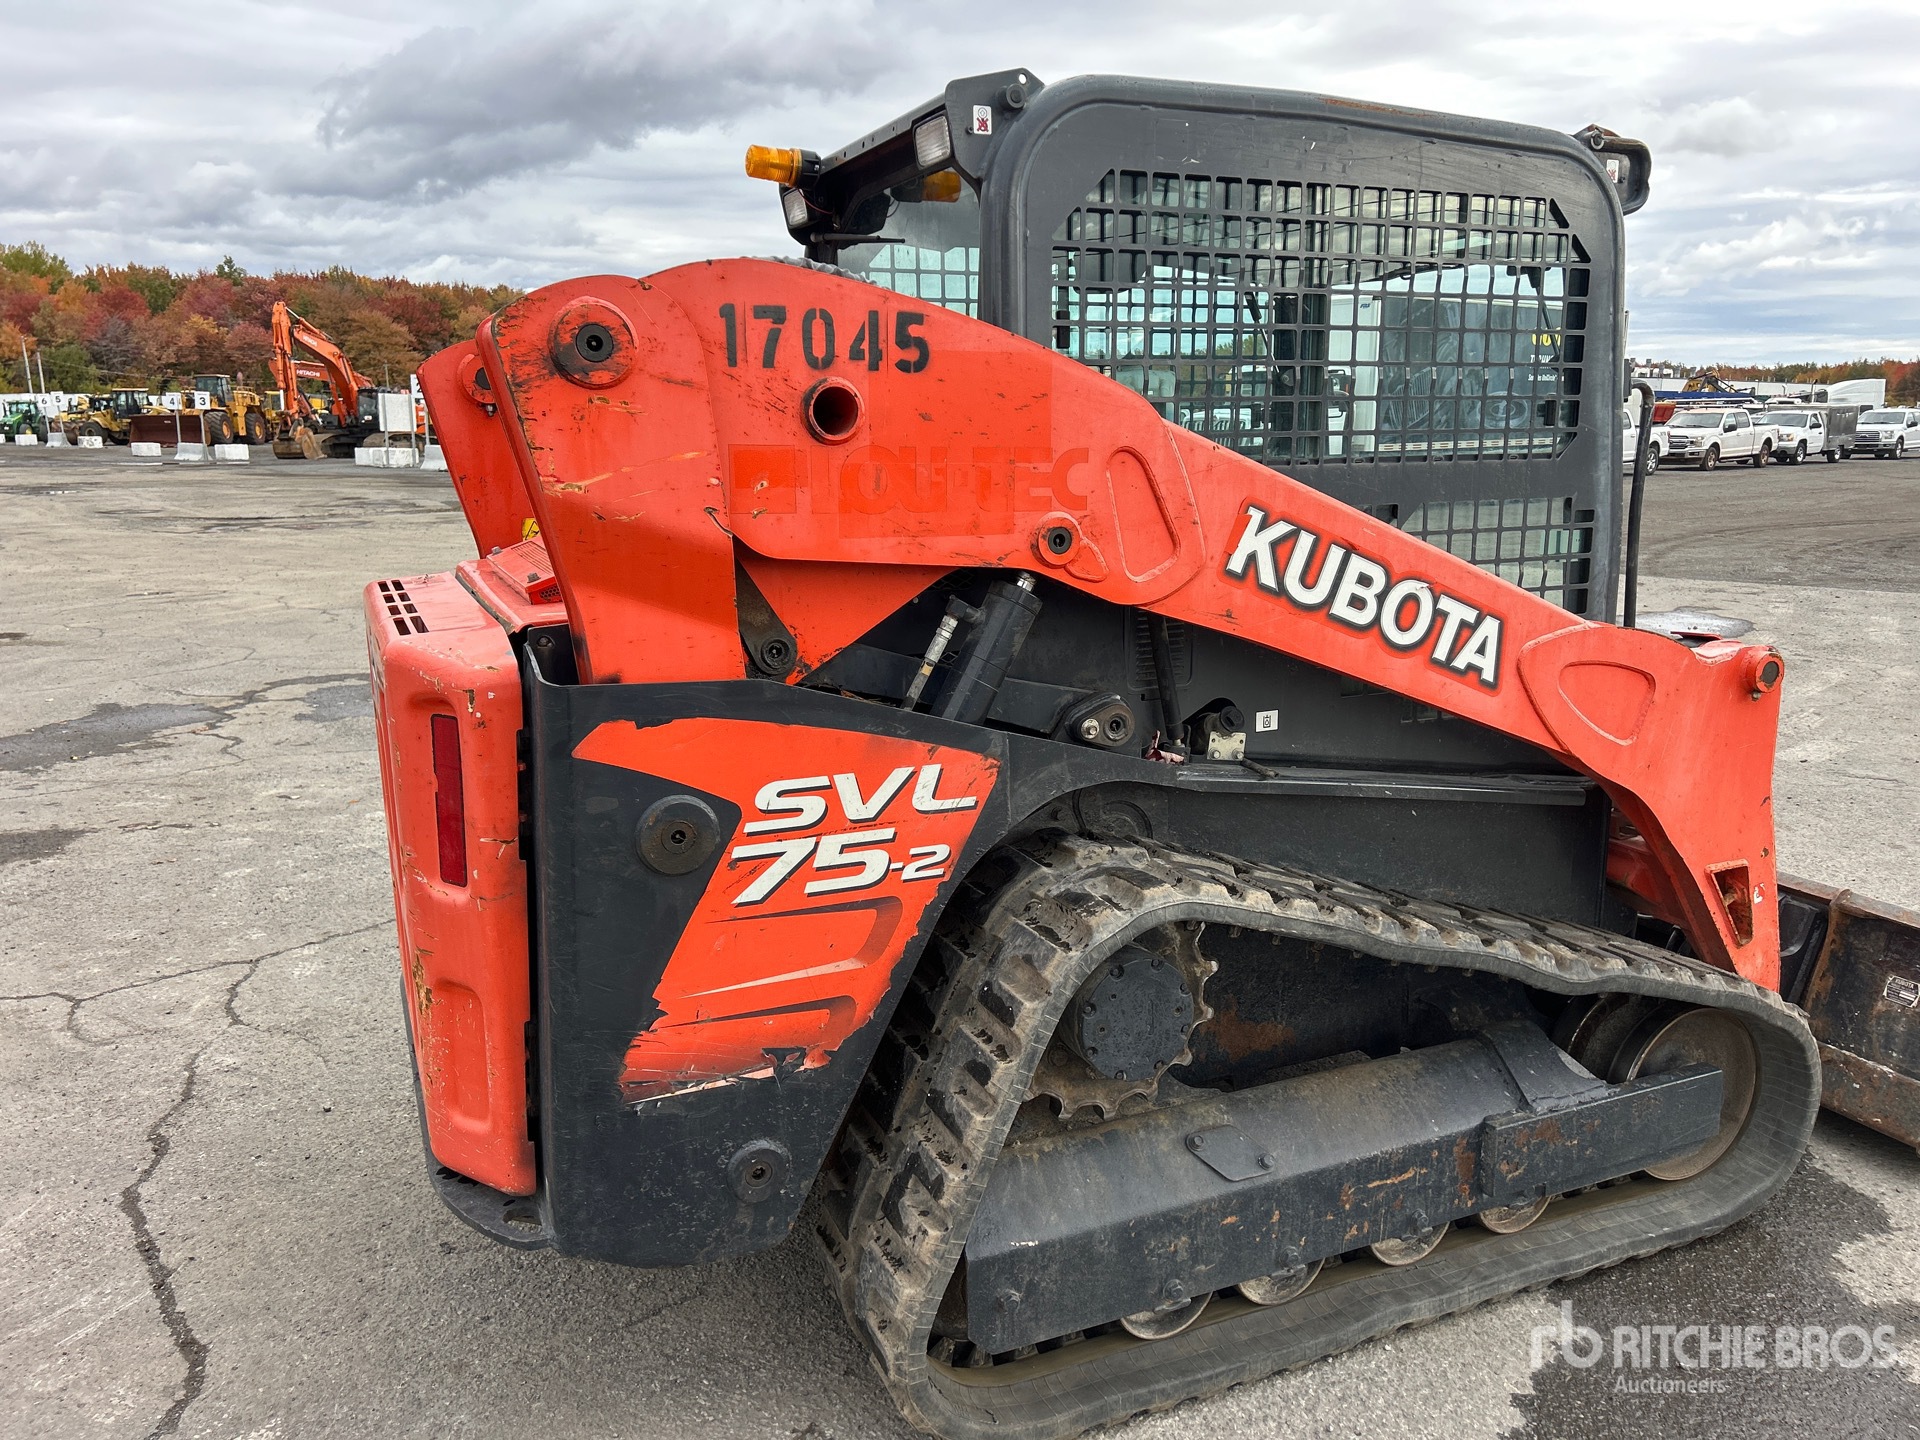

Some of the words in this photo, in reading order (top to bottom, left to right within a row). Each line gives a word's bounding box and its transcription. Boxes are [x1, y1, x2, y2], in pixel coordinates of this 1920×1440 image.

[719, 303, 930, 374] 17045
[296, 369, 321, 378] HITACHI
[55, 395, 62, 403] 5
[169, 397, 175, 406] 4
[199, 396, 206, 406] 3
[1226, 505, 1502, 685] KUBOTA
[743, 763, 978, 836] SVL
[730, 827, 951, 908] 75-2
